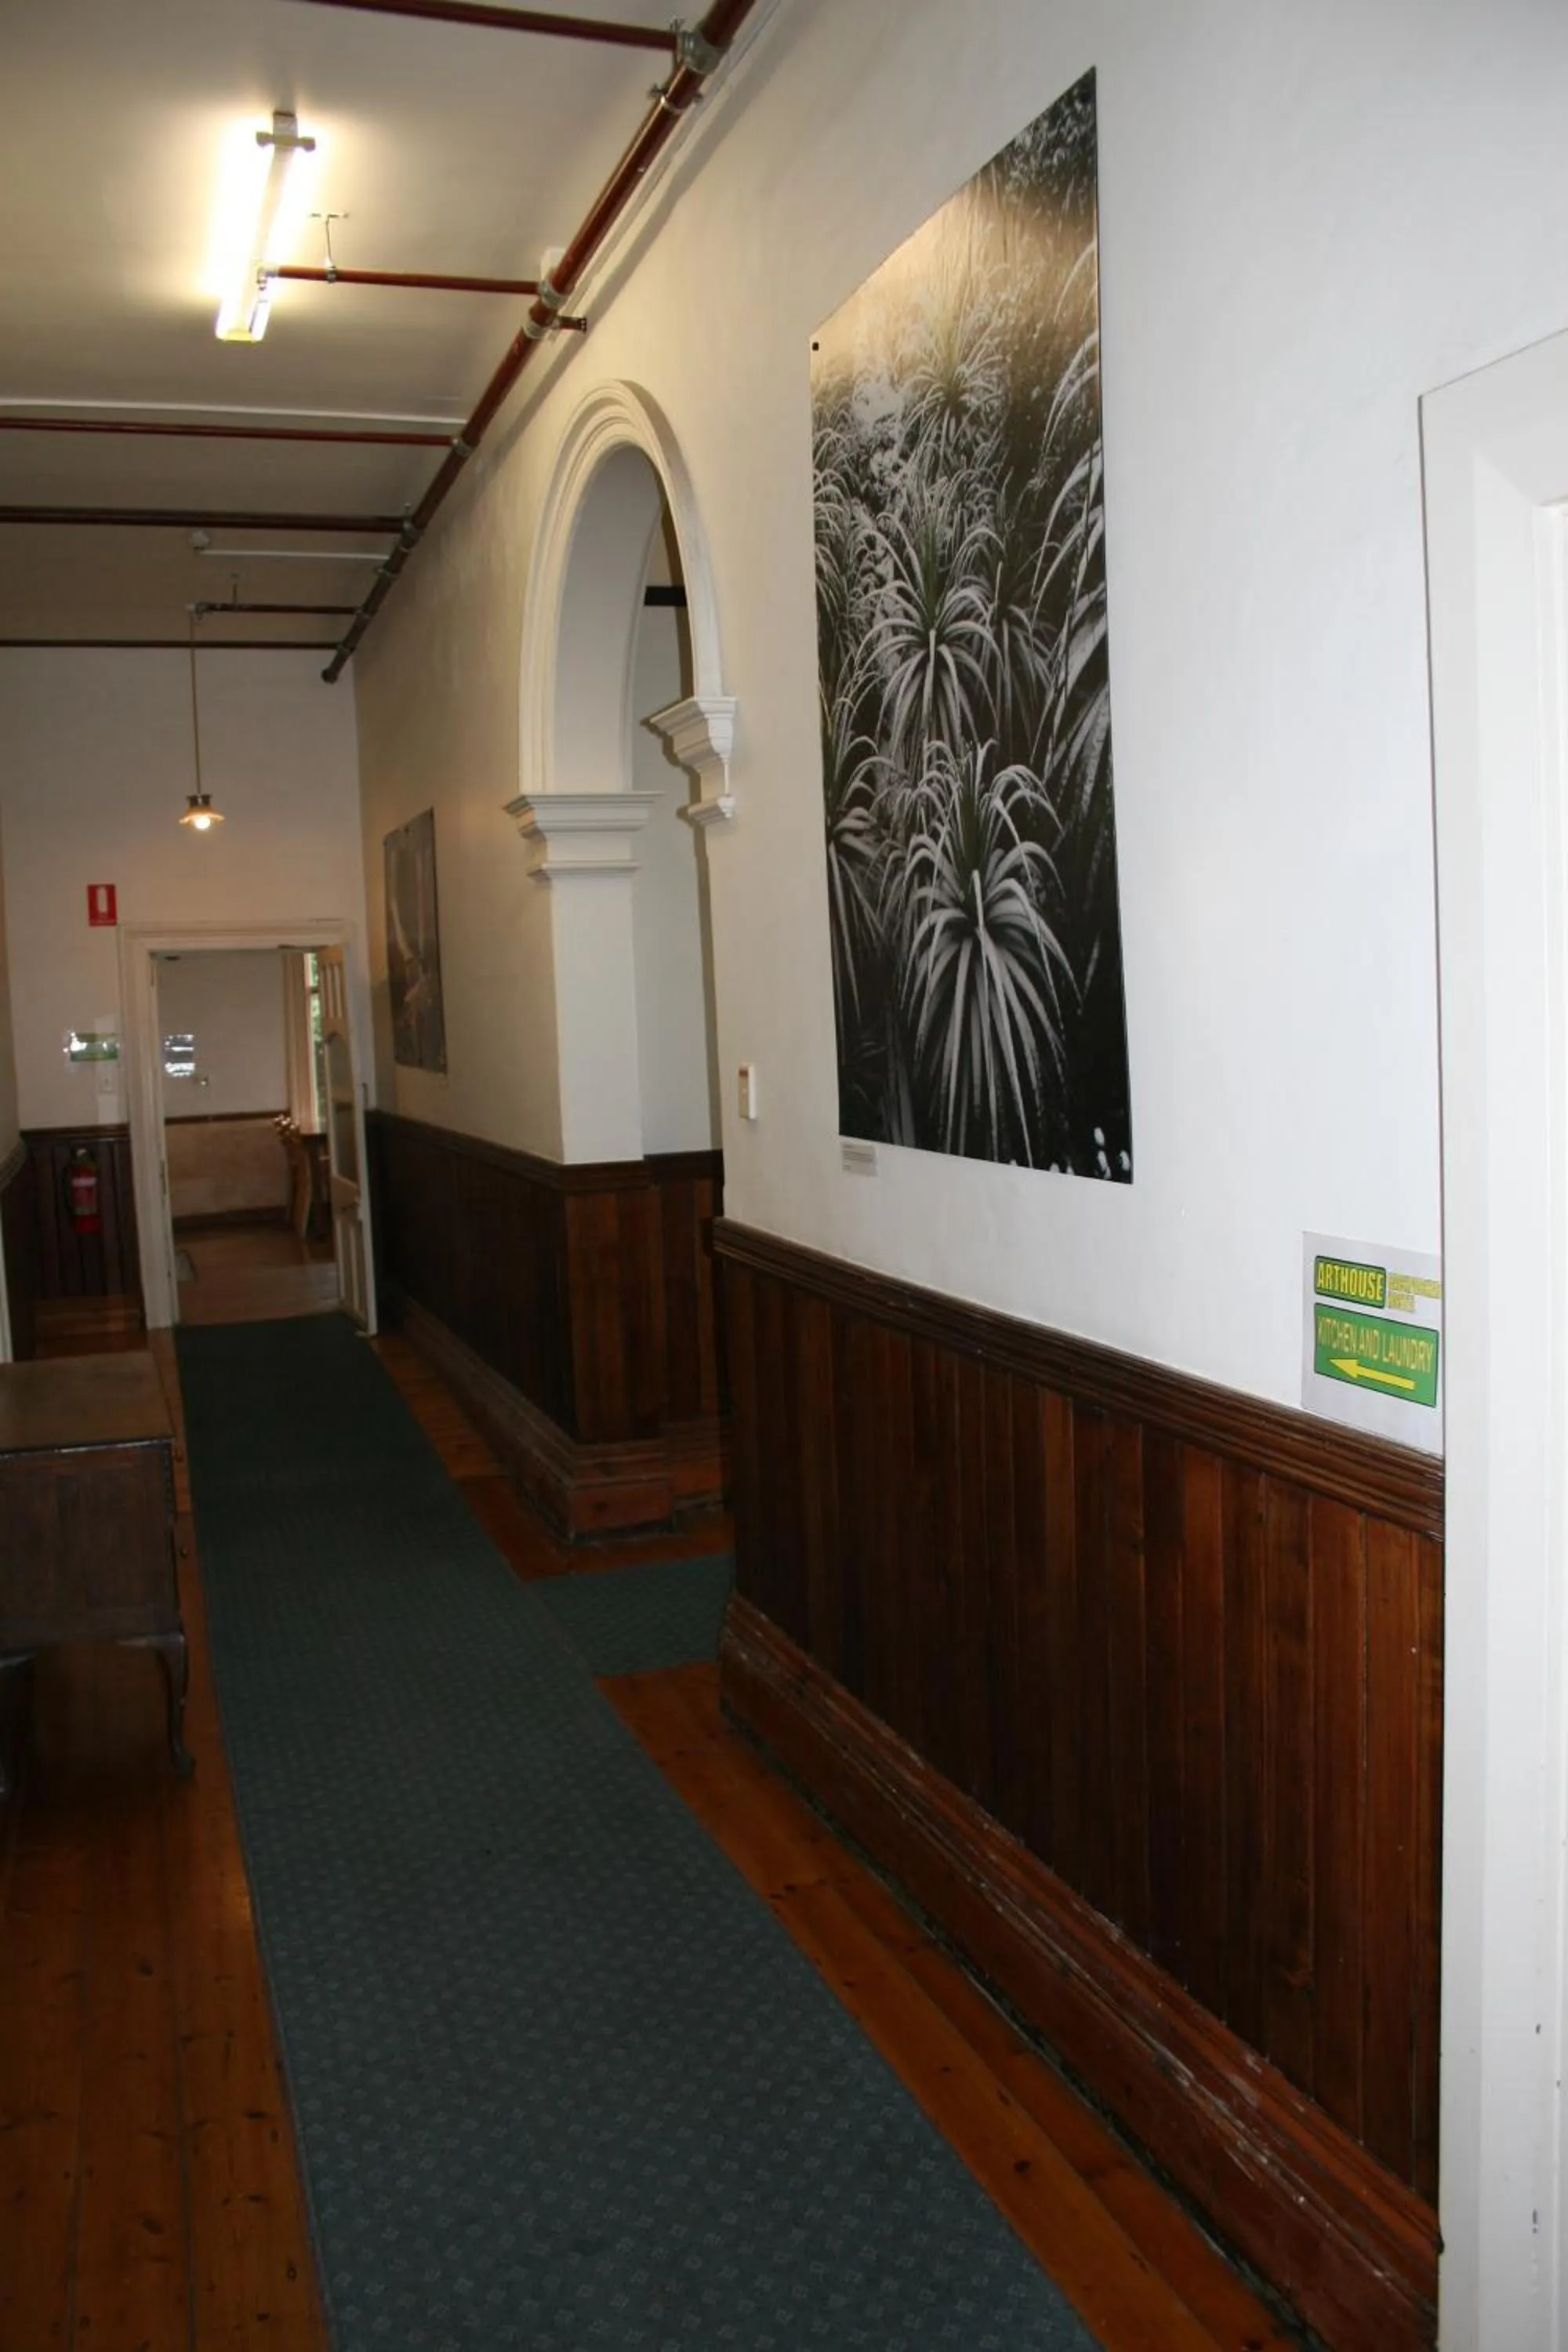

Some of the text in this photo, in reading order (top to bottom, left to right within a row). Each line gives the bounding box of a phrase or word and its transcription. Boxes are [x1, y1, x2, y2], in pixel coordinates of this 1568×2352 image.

[1317, 1261, 1383, 1301] ARTHOUSE
[1317, 1316, 1434, 1373] KITCHEN AND LAUNDRY
